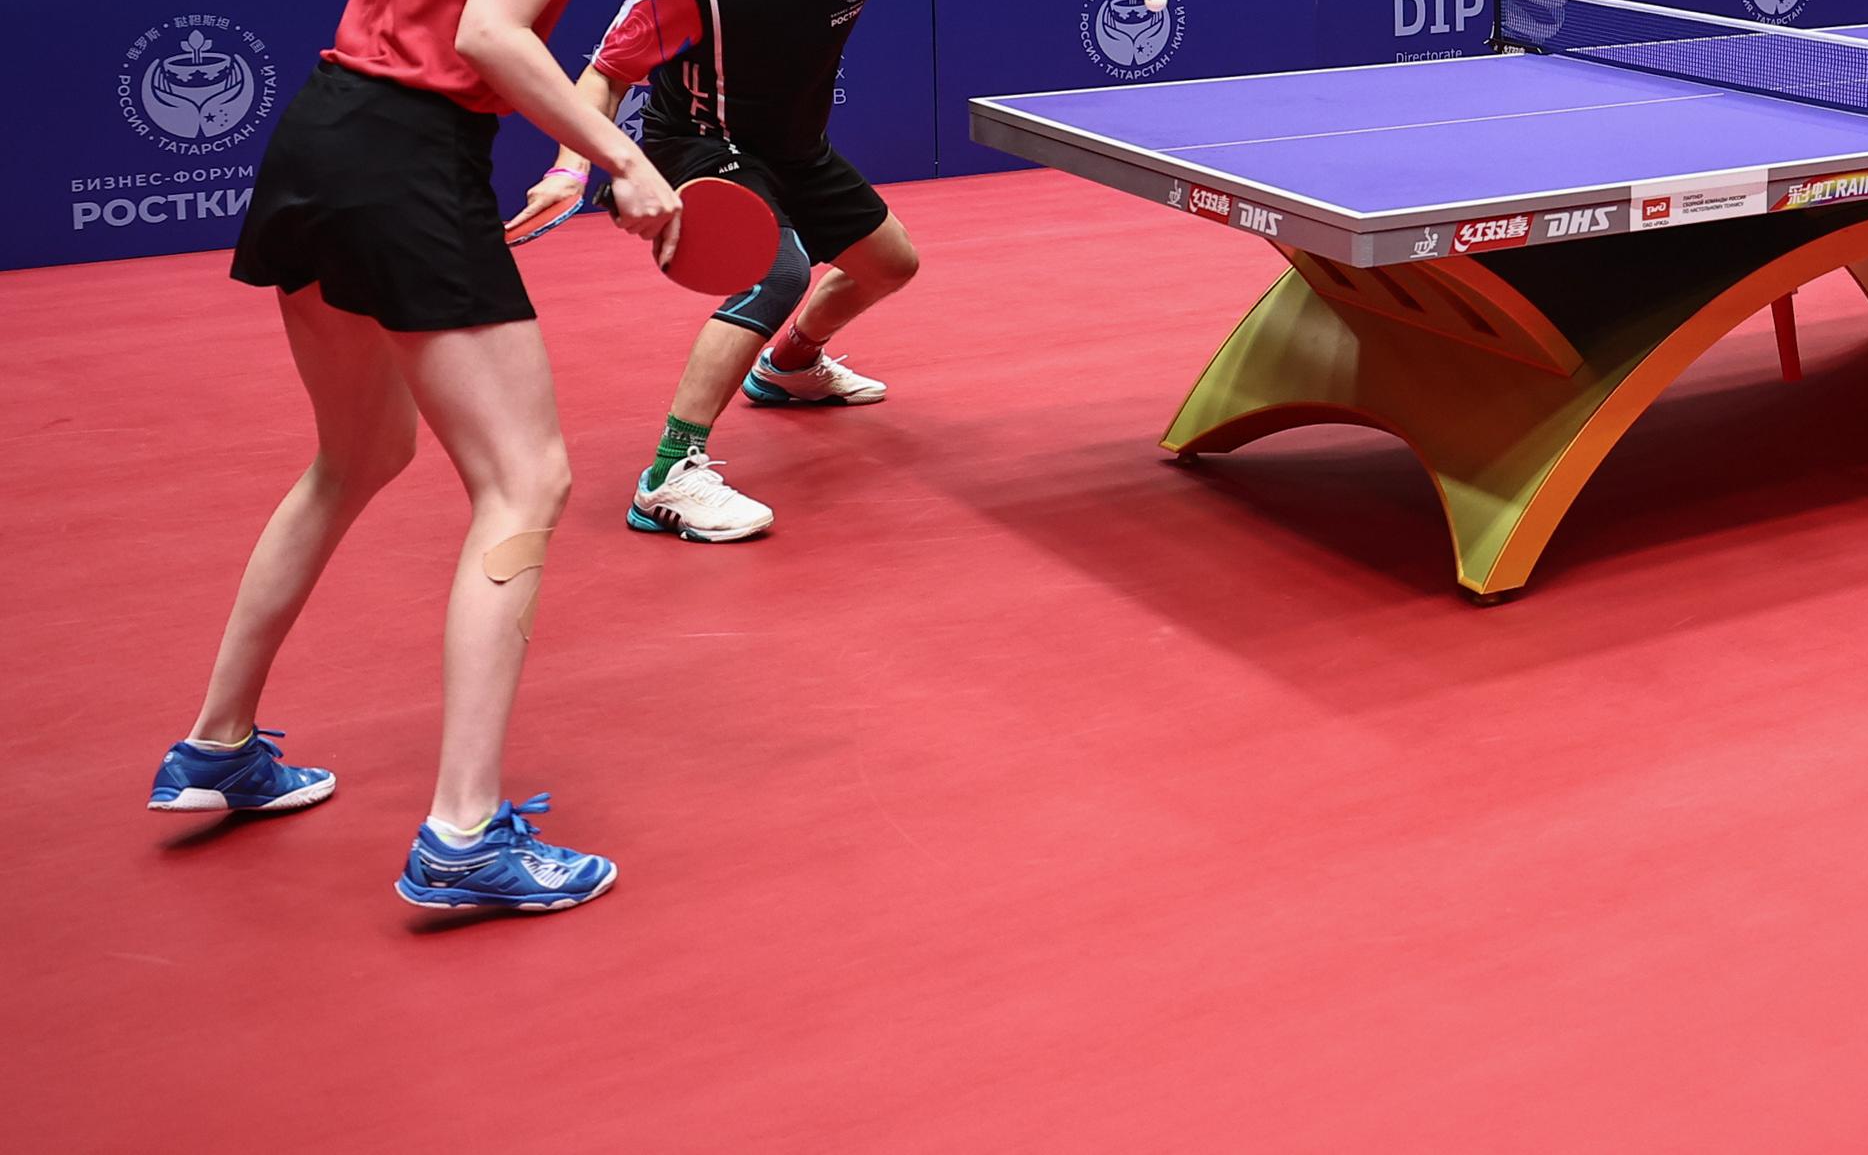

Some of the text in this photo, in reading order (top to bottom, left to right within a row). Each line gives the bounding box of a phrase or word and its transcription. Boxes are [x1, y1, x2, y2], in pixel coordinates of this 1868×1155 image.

[1756, 5, 1803, 25] ТАТАРСТАН
[242, 31, 266, 53] 中国
[1079, 6, 1186, 80] РОССИЯ ТАТАРСТАН КИТАЙ
[1396, 48, 1463, 63] Directorate
[118, 65, 277, 156] РОССИЯ ТАТАРСТАН КИТАЙ
[71, 165, 254, 192] БИЗНЕС-ФОРУМ
[718, 161, 740, 174] ALGA
[1787, 180, 1834, 205] 彩虹
[72, 187, 254, 230] РОСТКИ
[1191, 187, 1283, 236] 红双喜 DHS
[1456, 205, 1618, 246] 红双喜 DHS
